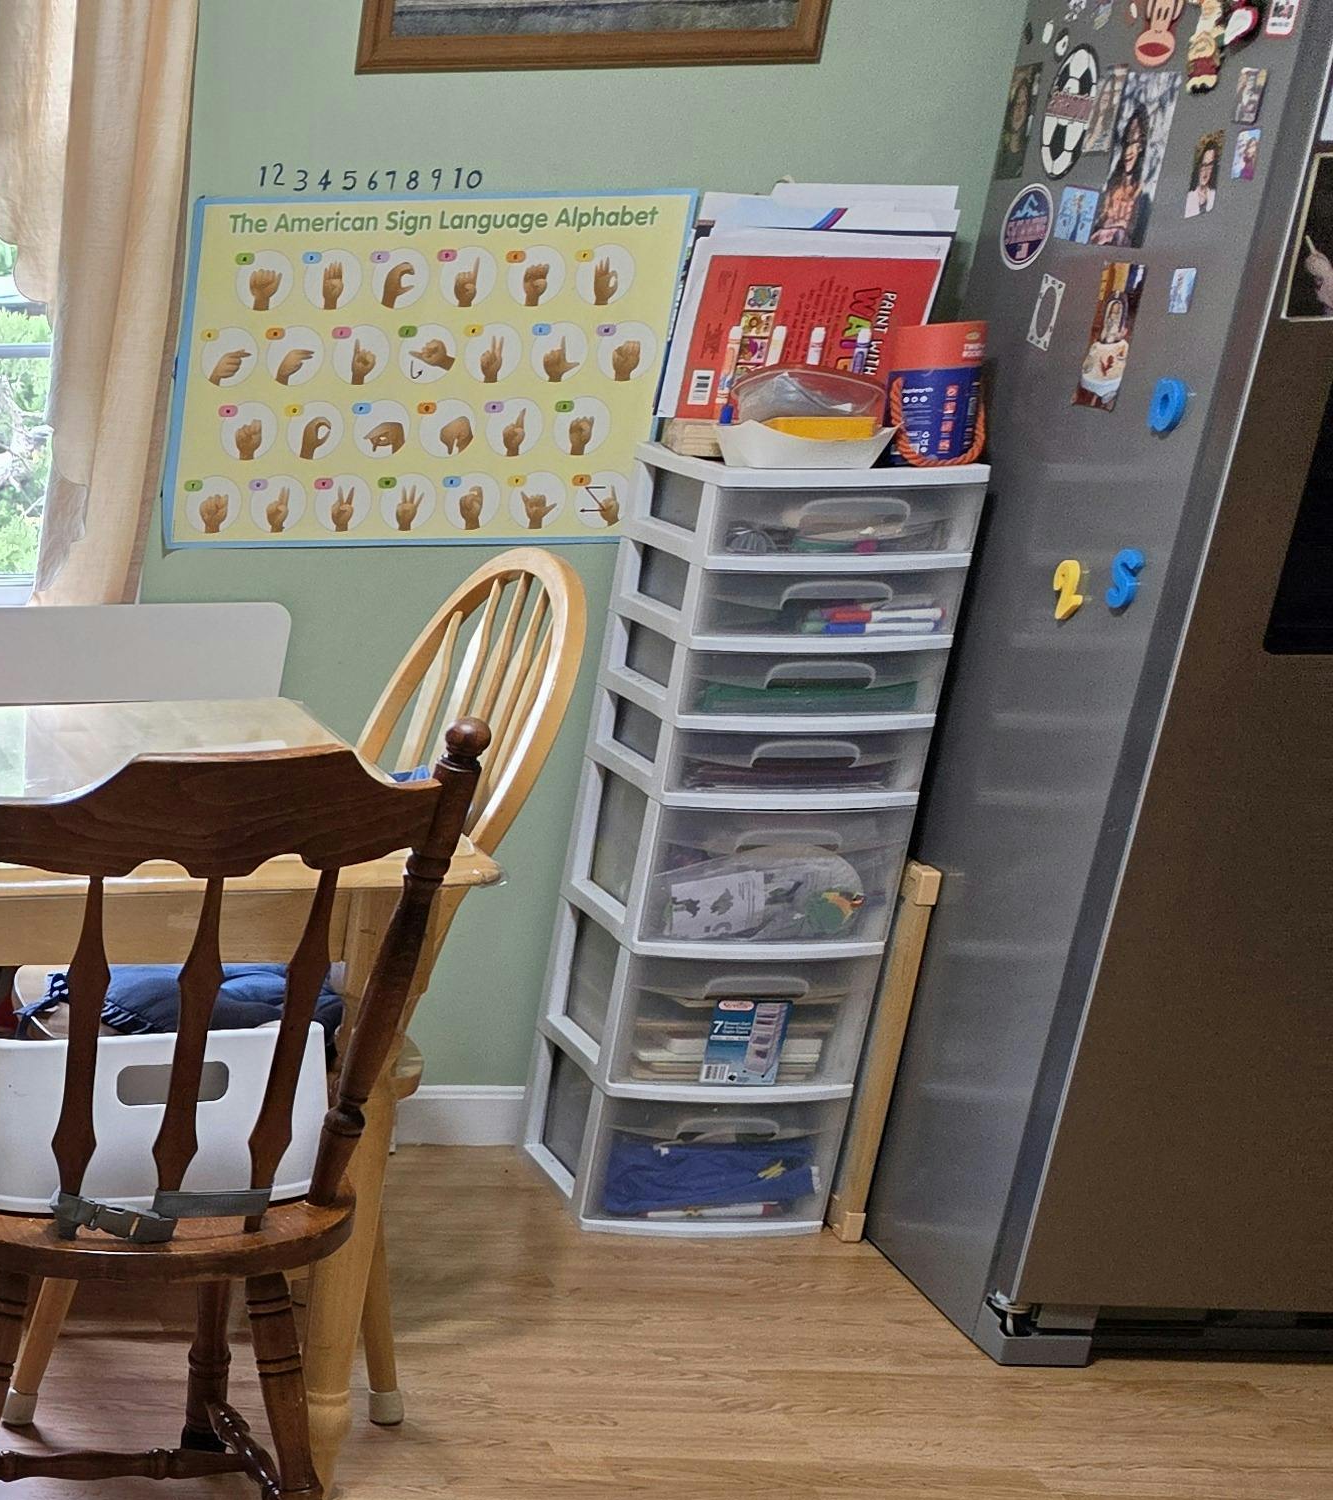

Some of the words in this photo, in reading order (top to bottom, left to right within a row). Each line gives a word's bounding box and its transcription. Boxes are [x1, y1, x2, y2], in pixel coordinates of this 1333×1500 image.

[259, 166, 267, 186] 1
[273, 162, 285, 186] 2
[293, 169, 308, 191] 3
[318, 168, 332, 191] 4
[341, 170, 357, 191] 5
[368, 170, 378, 190] 6
[385, 170, 396, 190] 7
[405, 170, 420, 190] 8
[432, 168, 442, 191] 9
[454, 168, 483, 189] 10
[229, 213, 268, 234] The
[274, 212, 378, 234] American
[385, 210, 431, 236] Sign
[438, 210, 548, 235] Language
[555, 205, 659, 232] Alphabet
[873, 290, 898, 334] PAINT
[863, 339, 883, 376] WITH
[713, 1020, 724, 1034] 7
